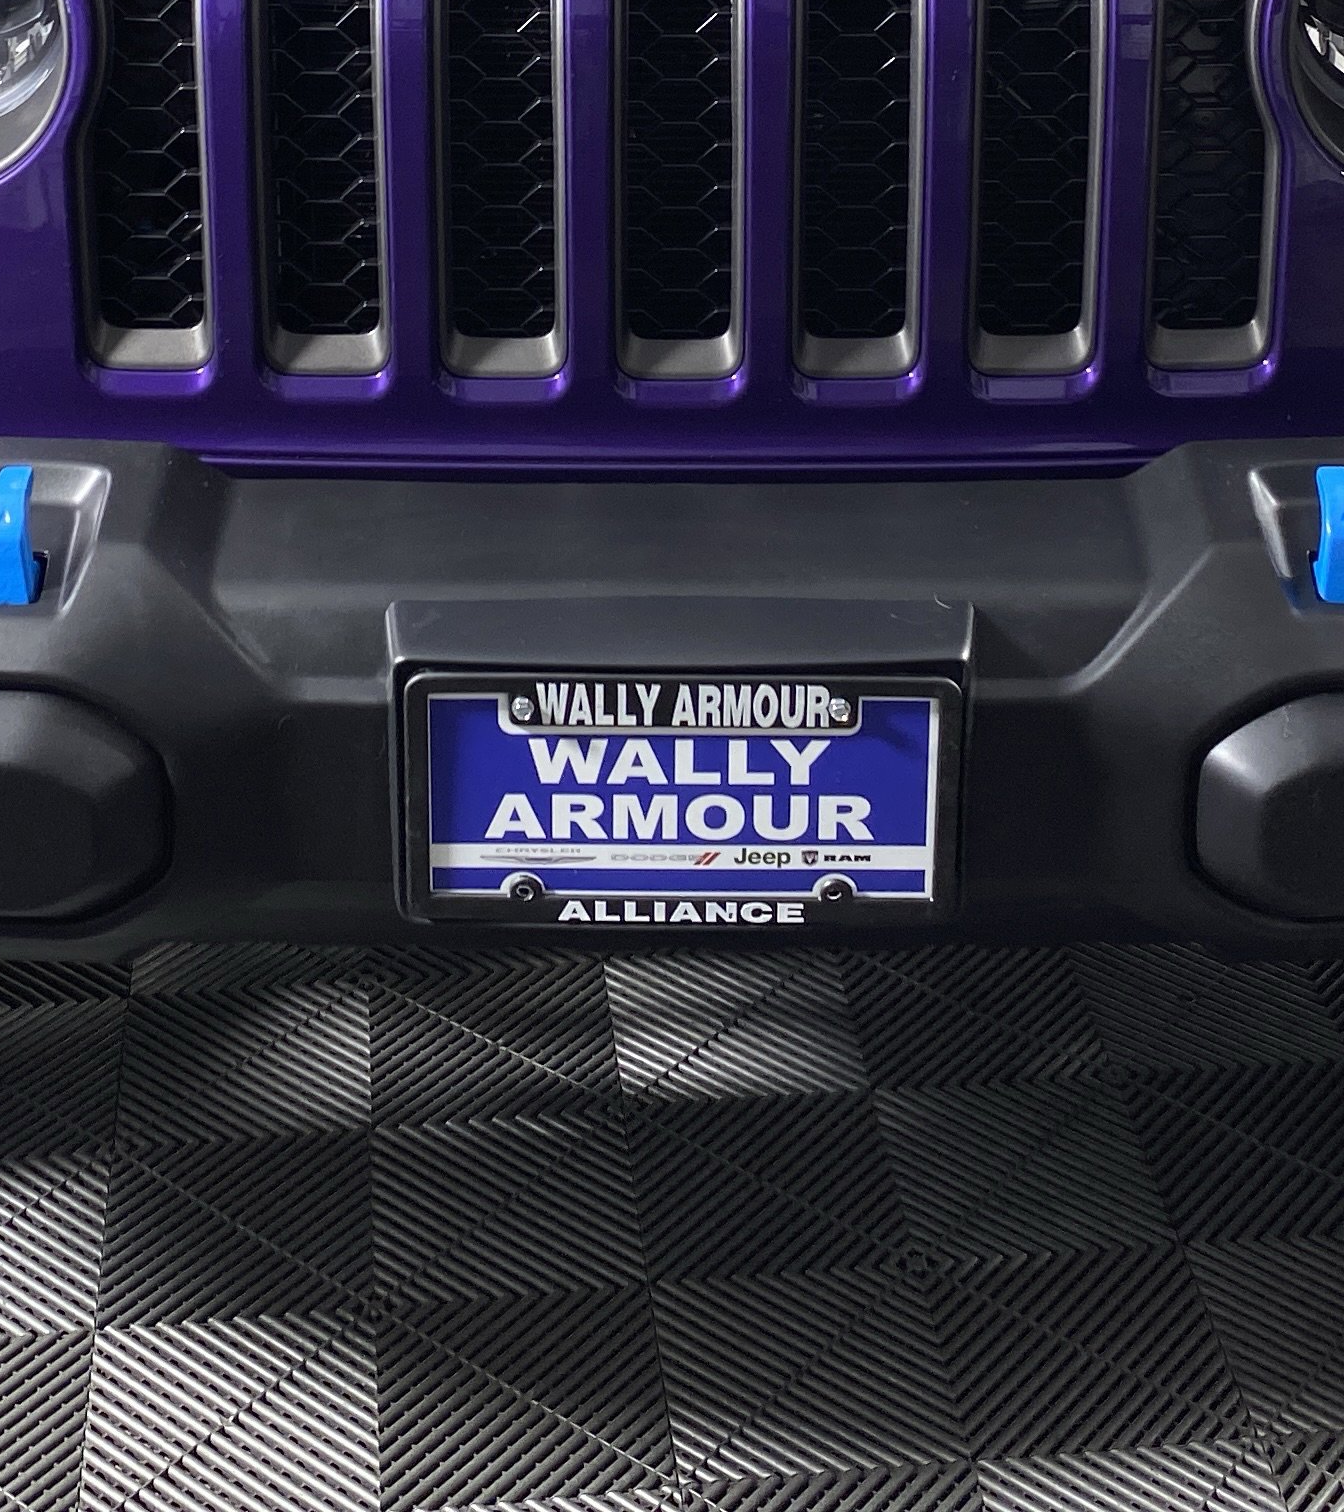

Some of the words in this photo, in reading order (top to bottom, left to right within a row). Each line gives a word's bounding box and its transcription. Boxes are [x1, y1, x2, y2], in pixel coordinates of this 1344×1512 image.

[536, 682, 661, 726] WALLY
[671, 683, 831, 728] ARMOUR
[528, 738, 832, 786] WALLY
[483, 793, 875, 841] ARMOUR
[733, 847, 792, 868] Jeep
[823, 854, 872, 862] RAM
[557, 900, 806, 924] ALLIANCE
